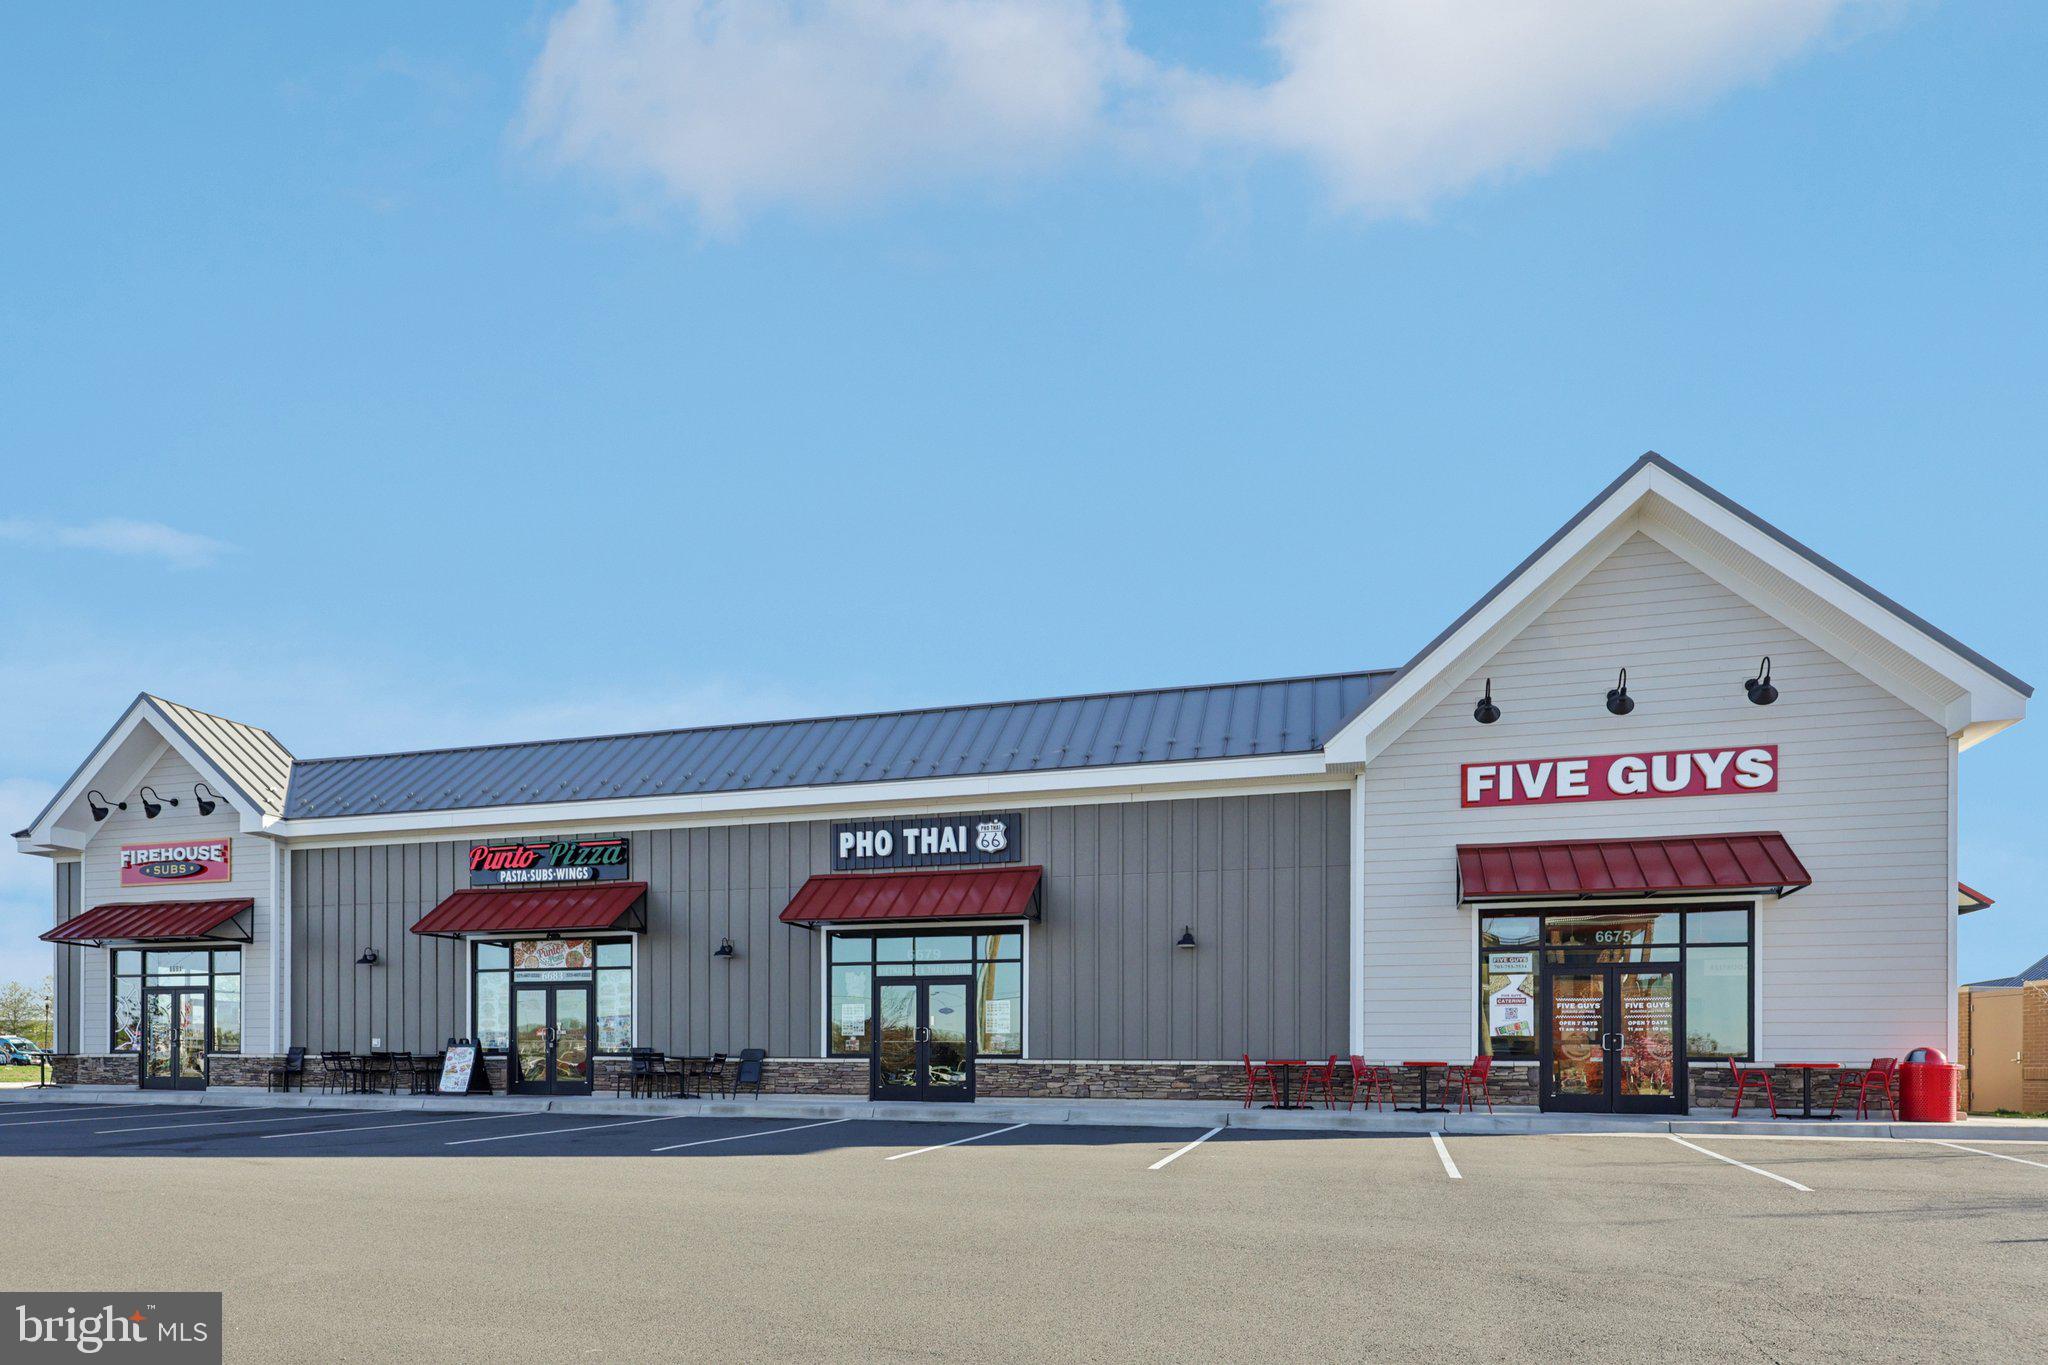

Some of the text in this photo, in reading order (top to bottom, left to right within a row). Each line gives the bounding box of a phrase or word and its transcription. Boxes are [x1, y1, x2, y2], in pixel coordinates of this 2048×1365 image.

[1467, 748, 1774, 802] FIVE GUYS
[839, 825, 967, 858] PHO THAI
[981, 832, 1000, 848] 66
[120, 844, 224, 868] FIREHOUSE
[469, 841, 622, 870] Punto Pizza
[153, 864, 186, 875] SUBS
[1595, 930, 1632, 943] 6675
